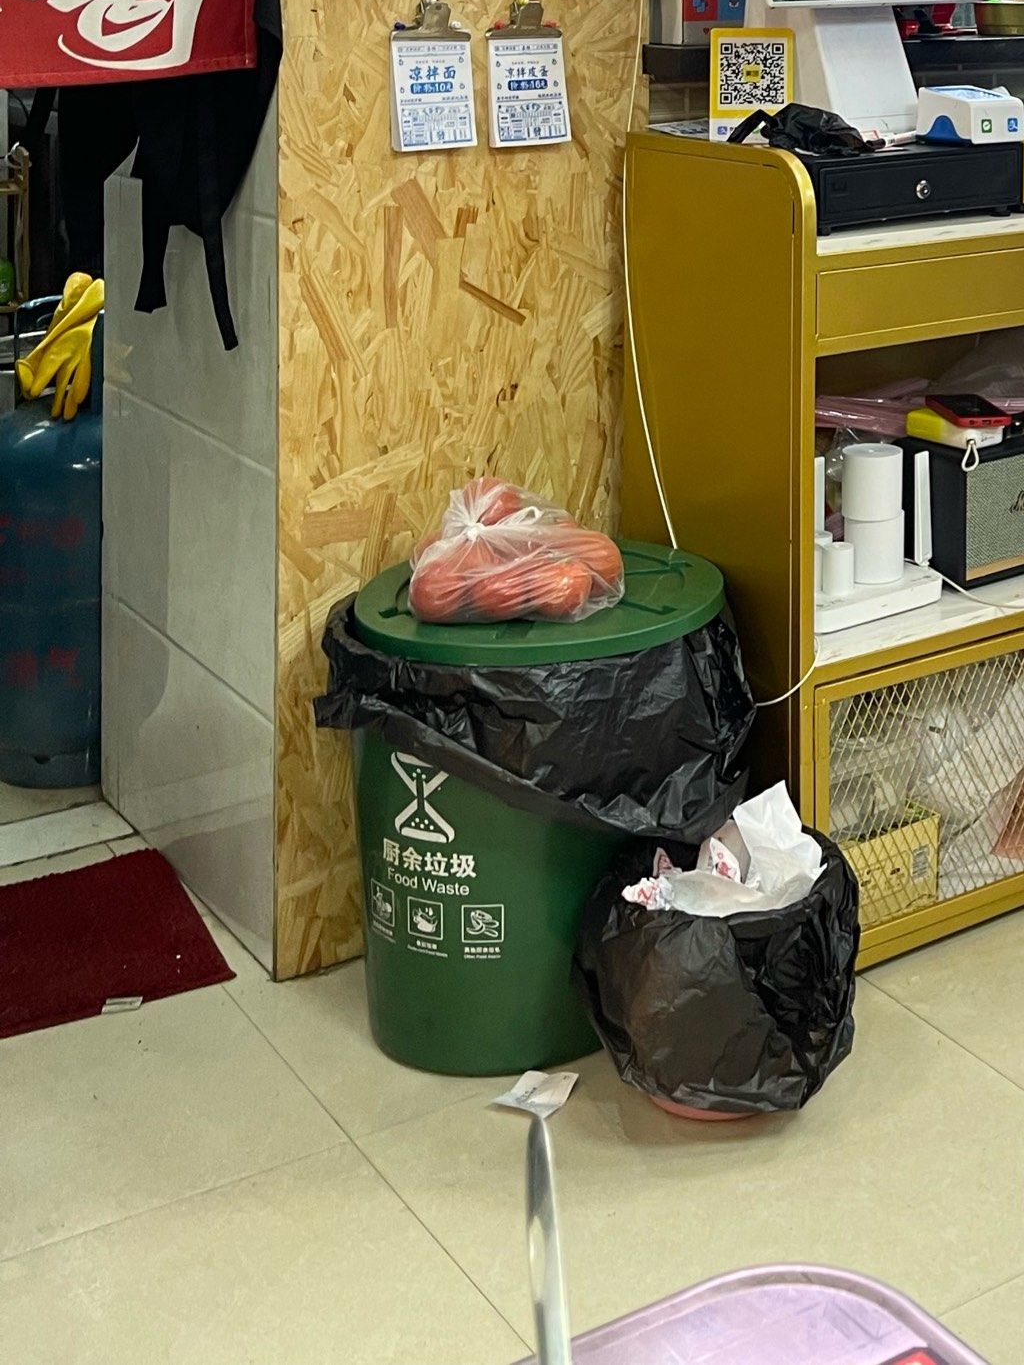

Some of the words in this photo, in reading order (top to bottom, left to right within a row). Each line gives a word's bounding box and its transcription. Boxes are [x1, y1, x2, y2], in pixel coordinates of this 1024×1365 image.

[383, 838, 477, 878] 厨余垃圾
[387, 867, 418, 889] Food
[421, 878, 470, 896] Waste
